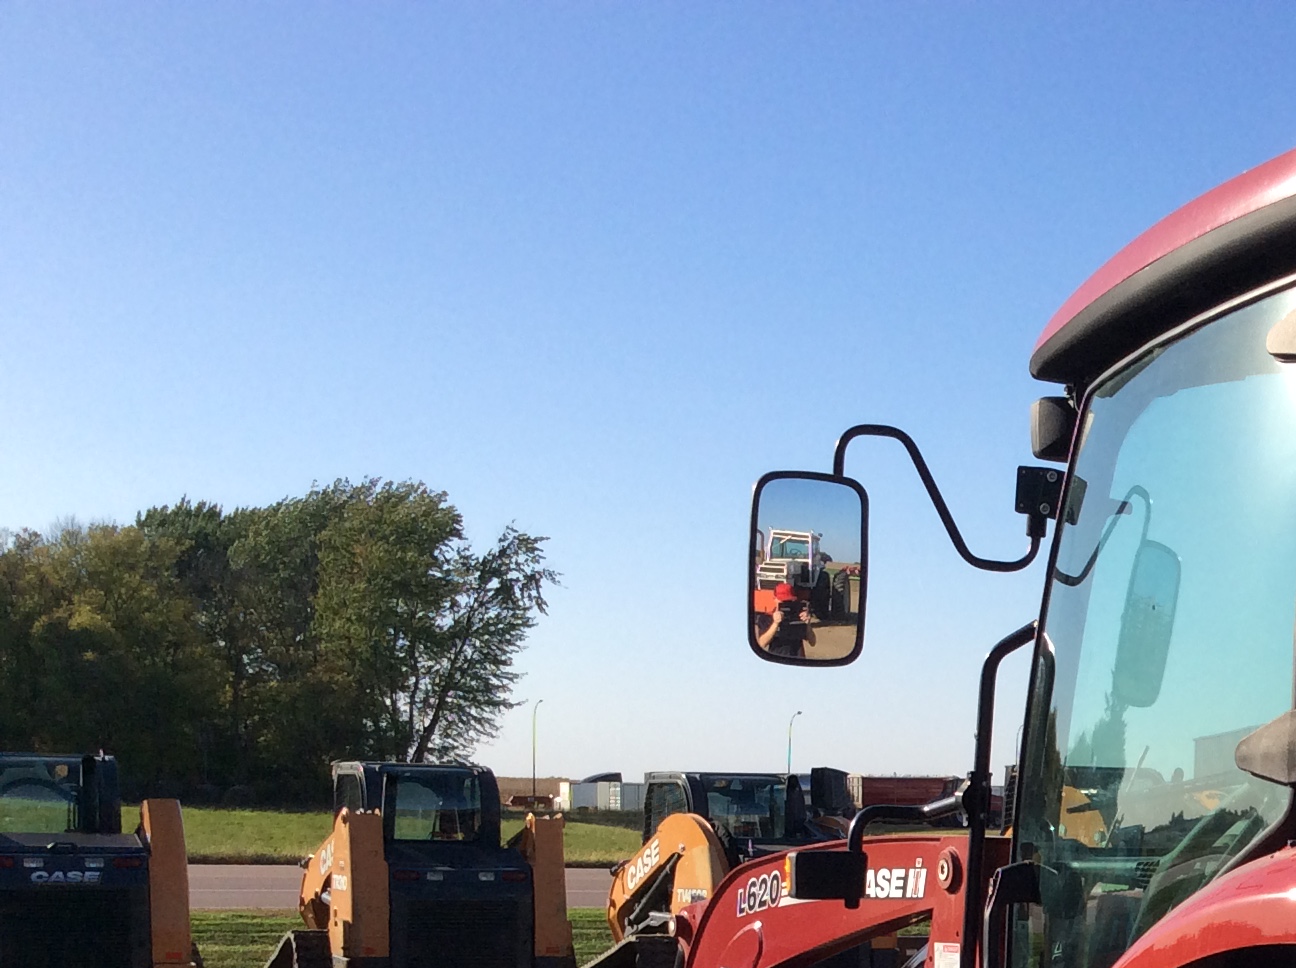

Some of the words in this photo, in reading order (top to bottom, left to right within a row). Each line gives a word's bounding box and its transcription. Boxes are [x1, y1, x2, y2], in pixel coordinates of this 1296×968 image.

[30, 870, 100, 882] CASE
[627, 838, 660, 890] CASE
[865, 867, 905, 899] ASE
[737, 870, 782, 917] L620
